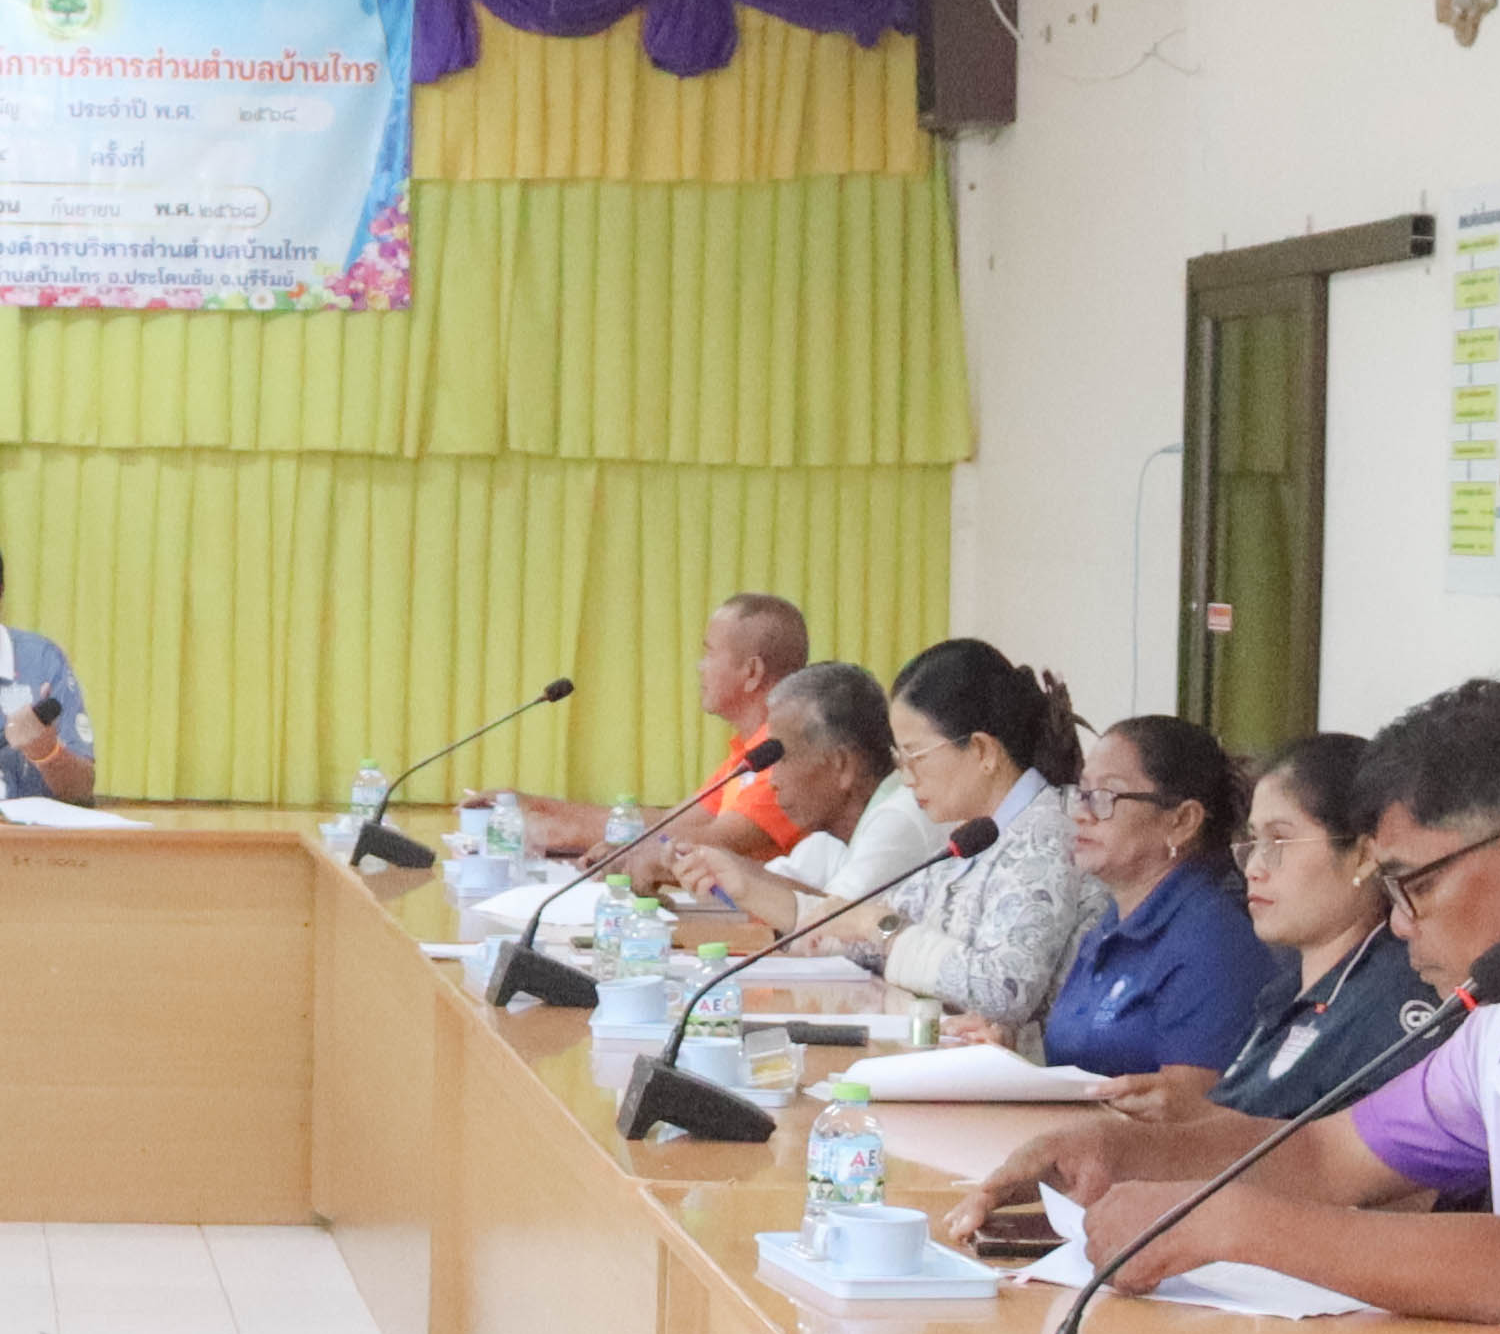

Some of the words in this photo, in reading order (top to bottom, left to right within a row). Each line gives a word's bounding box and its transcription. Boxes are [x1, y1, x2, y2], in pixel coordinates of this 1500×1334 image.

[67, 97, 148, 122] ประจำปี
[153, 104, 195, 121] พ.ศ.
[90, 139, 146, 169] ครั้งที่
[50, 194, 122, 218] กันยายน
[153, 200, 194, 218] พ.ศ.
